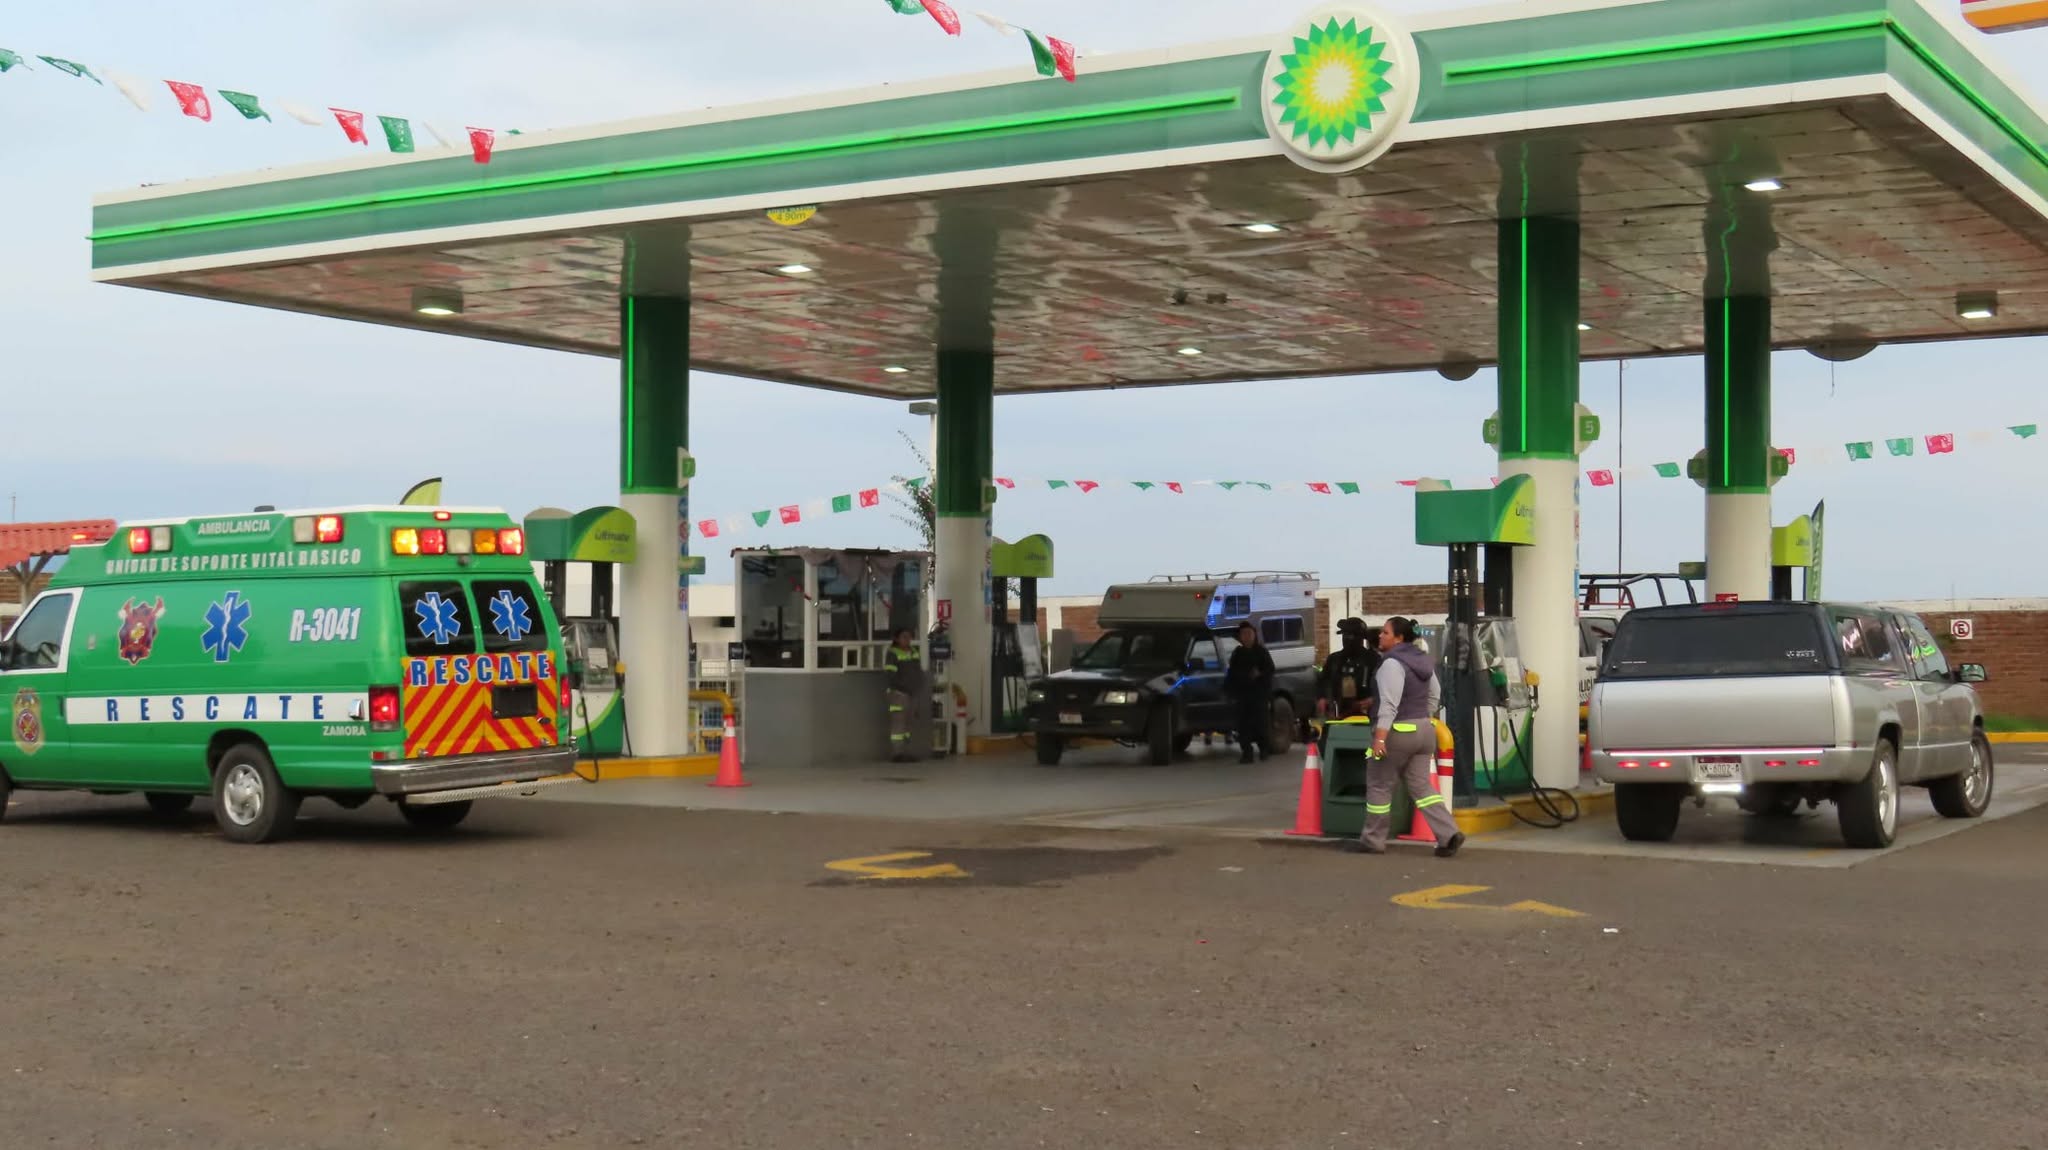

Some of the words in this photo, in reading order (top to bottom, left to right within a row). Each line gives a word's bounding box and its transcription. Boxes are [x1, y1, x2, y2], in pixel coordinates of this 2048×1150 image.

[198, 519, 271, 535] AMBULANCIA
[105, 559, 157, 575] UNIDAD
[161, 556, 178, 572] DE
[181, 553, 248, 570] SOPORTE
[252, 550, 296, 569] VITAL
[300, 547, 362, 566] BASICO
[290, 607, 361, 642] R-3041
[410, 652, 551, 687] RESCATE
[106, 695, 325, 722] RESCATE
[322, 725, 367, 737] ZAMORA
